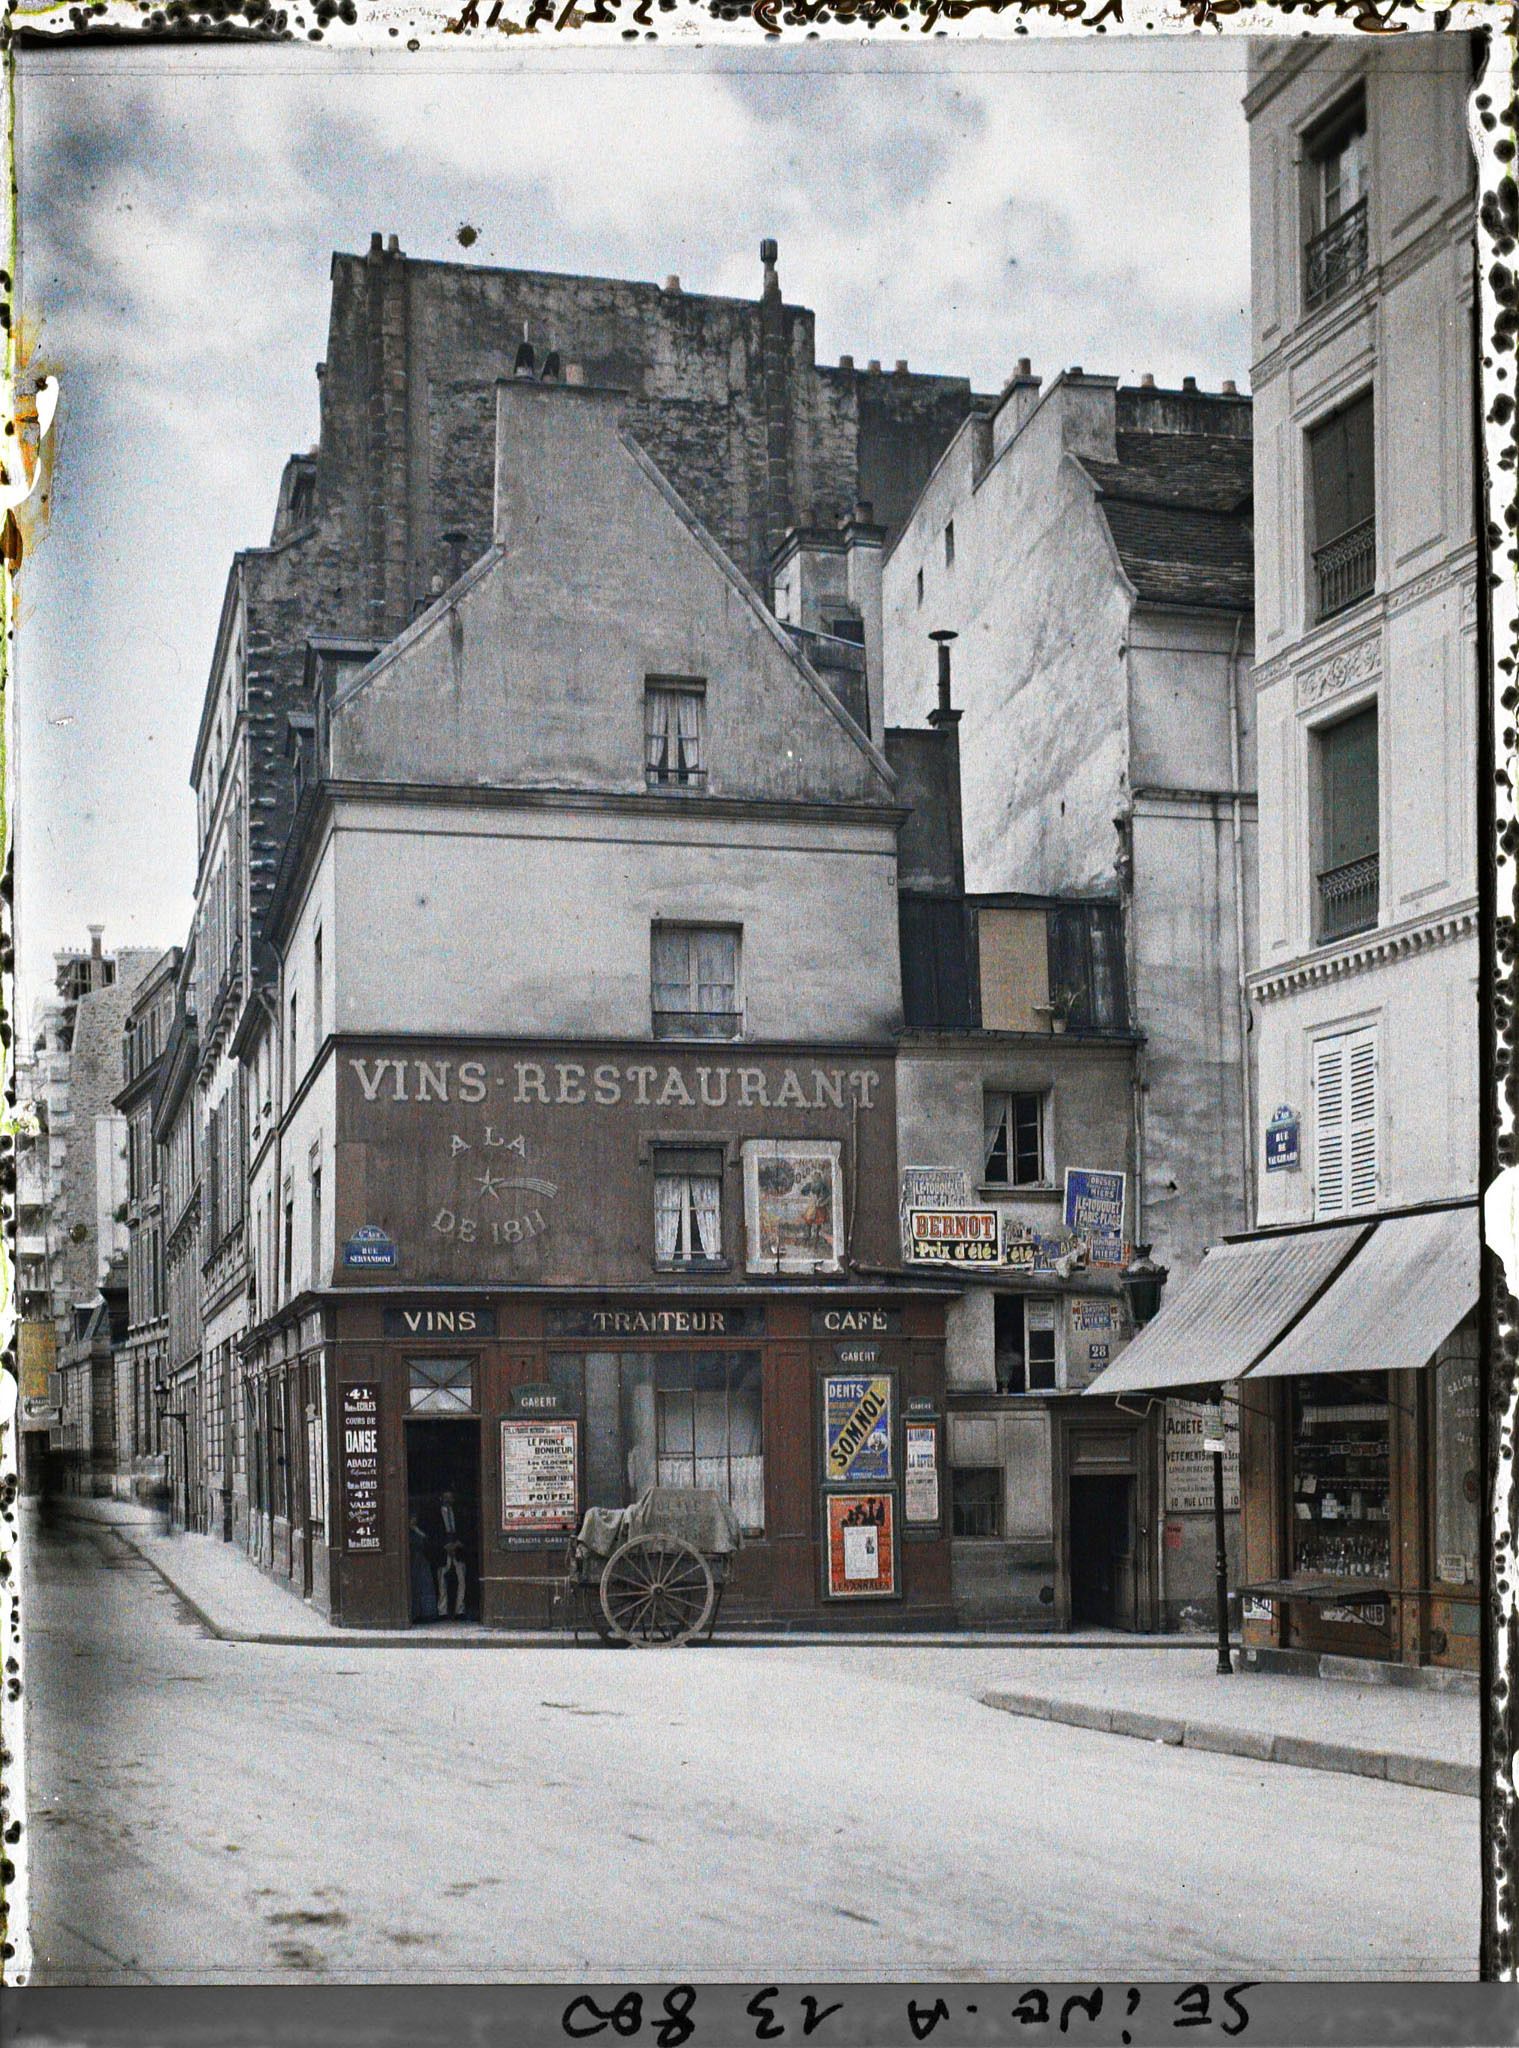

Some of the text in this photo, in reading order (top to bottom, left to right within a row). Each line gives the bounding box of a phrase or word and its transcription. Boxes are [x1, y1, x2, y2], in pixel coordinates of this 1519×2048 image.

[349, 1058, 880, 1109] VINS RESTAURANT
[431, 1207, 546, 1244] DE 1811
[914, 1214, 993, 1239] BERNOT
[362, 1247, 377, 1255] RUE
[403, 1311, 476, 1332] VINS
[593, 1311, 725, 1331] TRAITEUR
[824, 1308, 888, 1331] CAFÉ
[841, 1351, 877, 1362] GABERT
[521, 1396, 558, 1408] GABERT
[829, 1383, 865, 1399] DENTS
[831, 1391, 886, 1468] SOMNOL
[345, 1430, 378, 1453] DANSE
